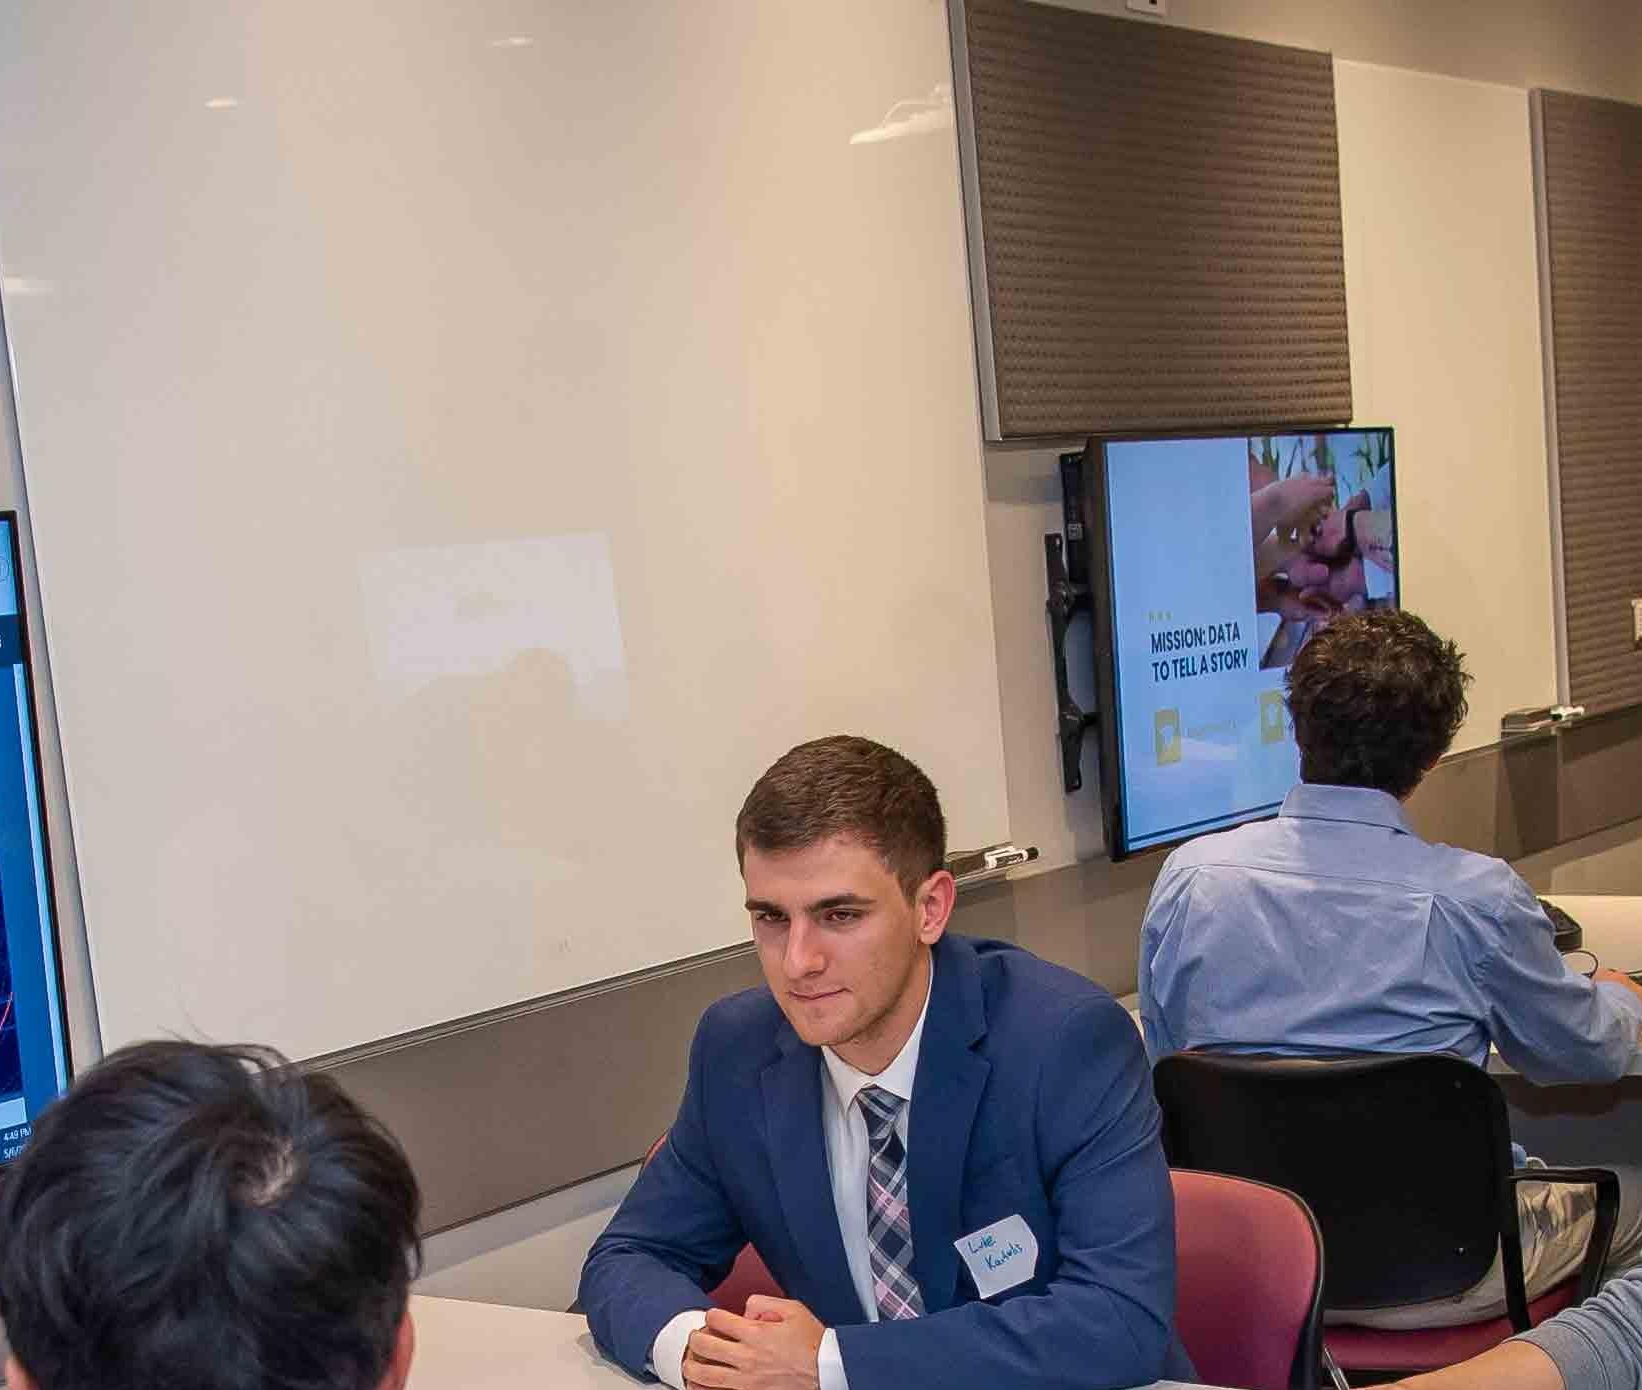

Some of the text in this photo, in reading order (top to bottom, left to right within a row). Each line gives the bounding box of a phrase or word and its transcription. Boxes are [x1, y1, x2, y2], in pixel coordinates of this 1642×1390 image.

[1151, 621, 1241, 655] MISSION: DATA
[1152, 647, 1249, 682] TO TELL A STORY
